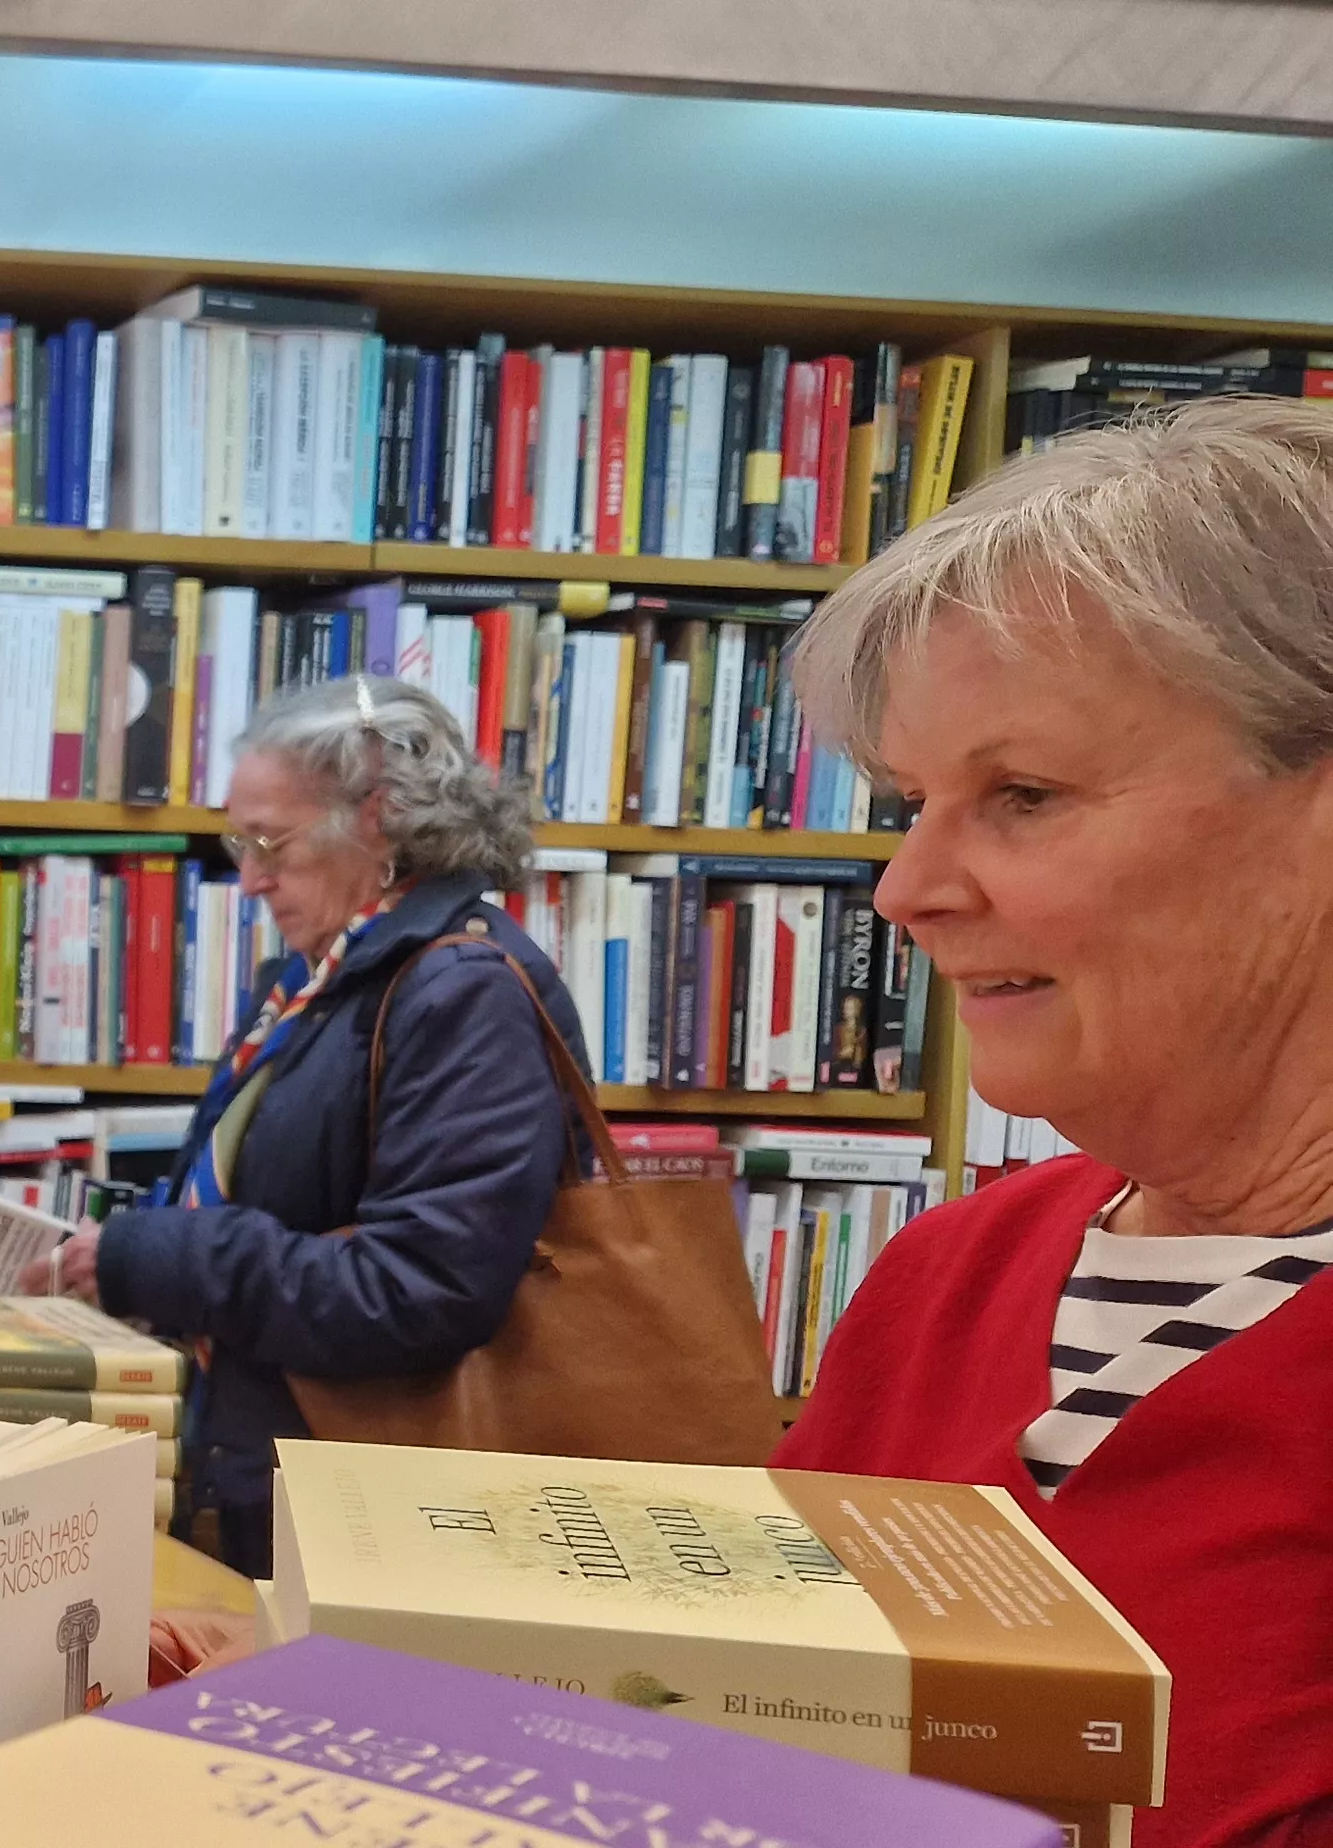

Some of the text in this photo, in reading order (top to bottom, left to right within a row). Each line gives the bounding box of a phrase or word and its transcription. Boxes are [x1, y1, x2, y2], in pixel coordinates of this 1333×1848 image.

[850, 909, 874, 990] BYRON
[1, 1507, 30, 1529] Vallejo
[49, 1502, 99, 1551] HABLÓ
[418, 1506, 497, 1535] El
[529, 1485, 631, 1583] infinito
[646, 1506, 732, 1577] en un
[3, 1546, 91, 1598] NOSOTROS
[755, 1515, 867, 1592] junco
[724, 1694, 746, 1714] El
[754, 1696, 847, 1725] infinito
[853, 1710, 882, 1728] en
[922, 1715, 998, 1742] junco
